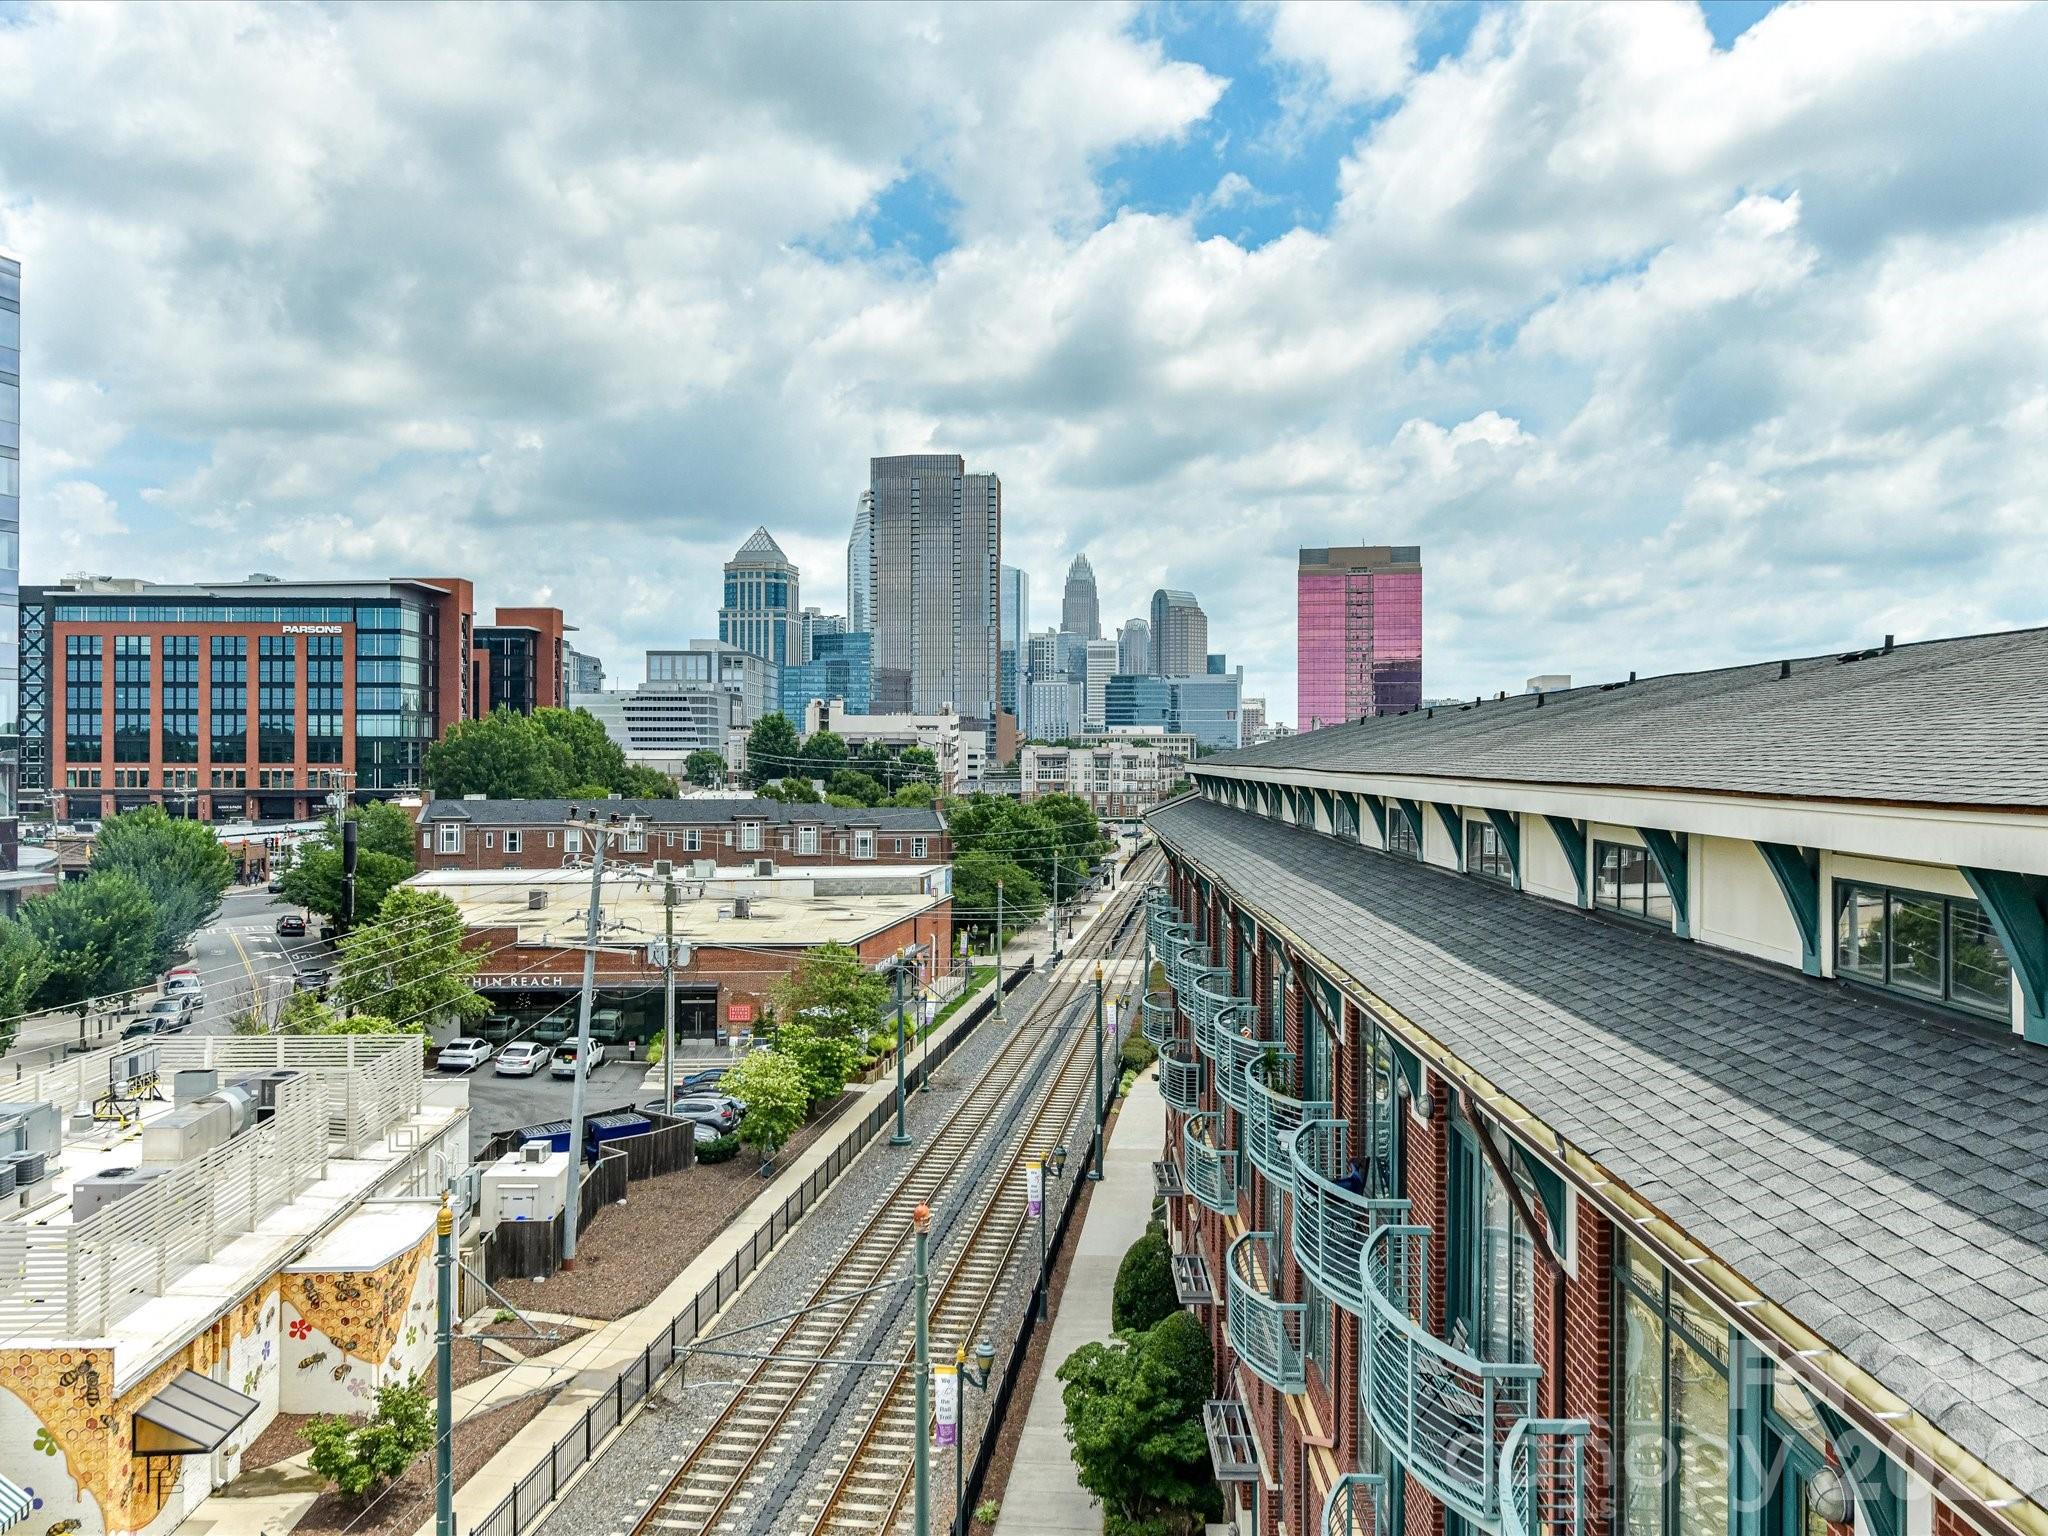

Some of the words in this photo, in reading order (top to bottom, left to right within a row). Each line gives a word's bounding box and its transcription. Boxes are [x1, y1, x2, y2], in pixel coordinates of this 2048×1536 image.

[282, 625, 343, 634] PARSONS
[462, 977, 502, 987] THIN
[510, 976, 563, 987] REACH
